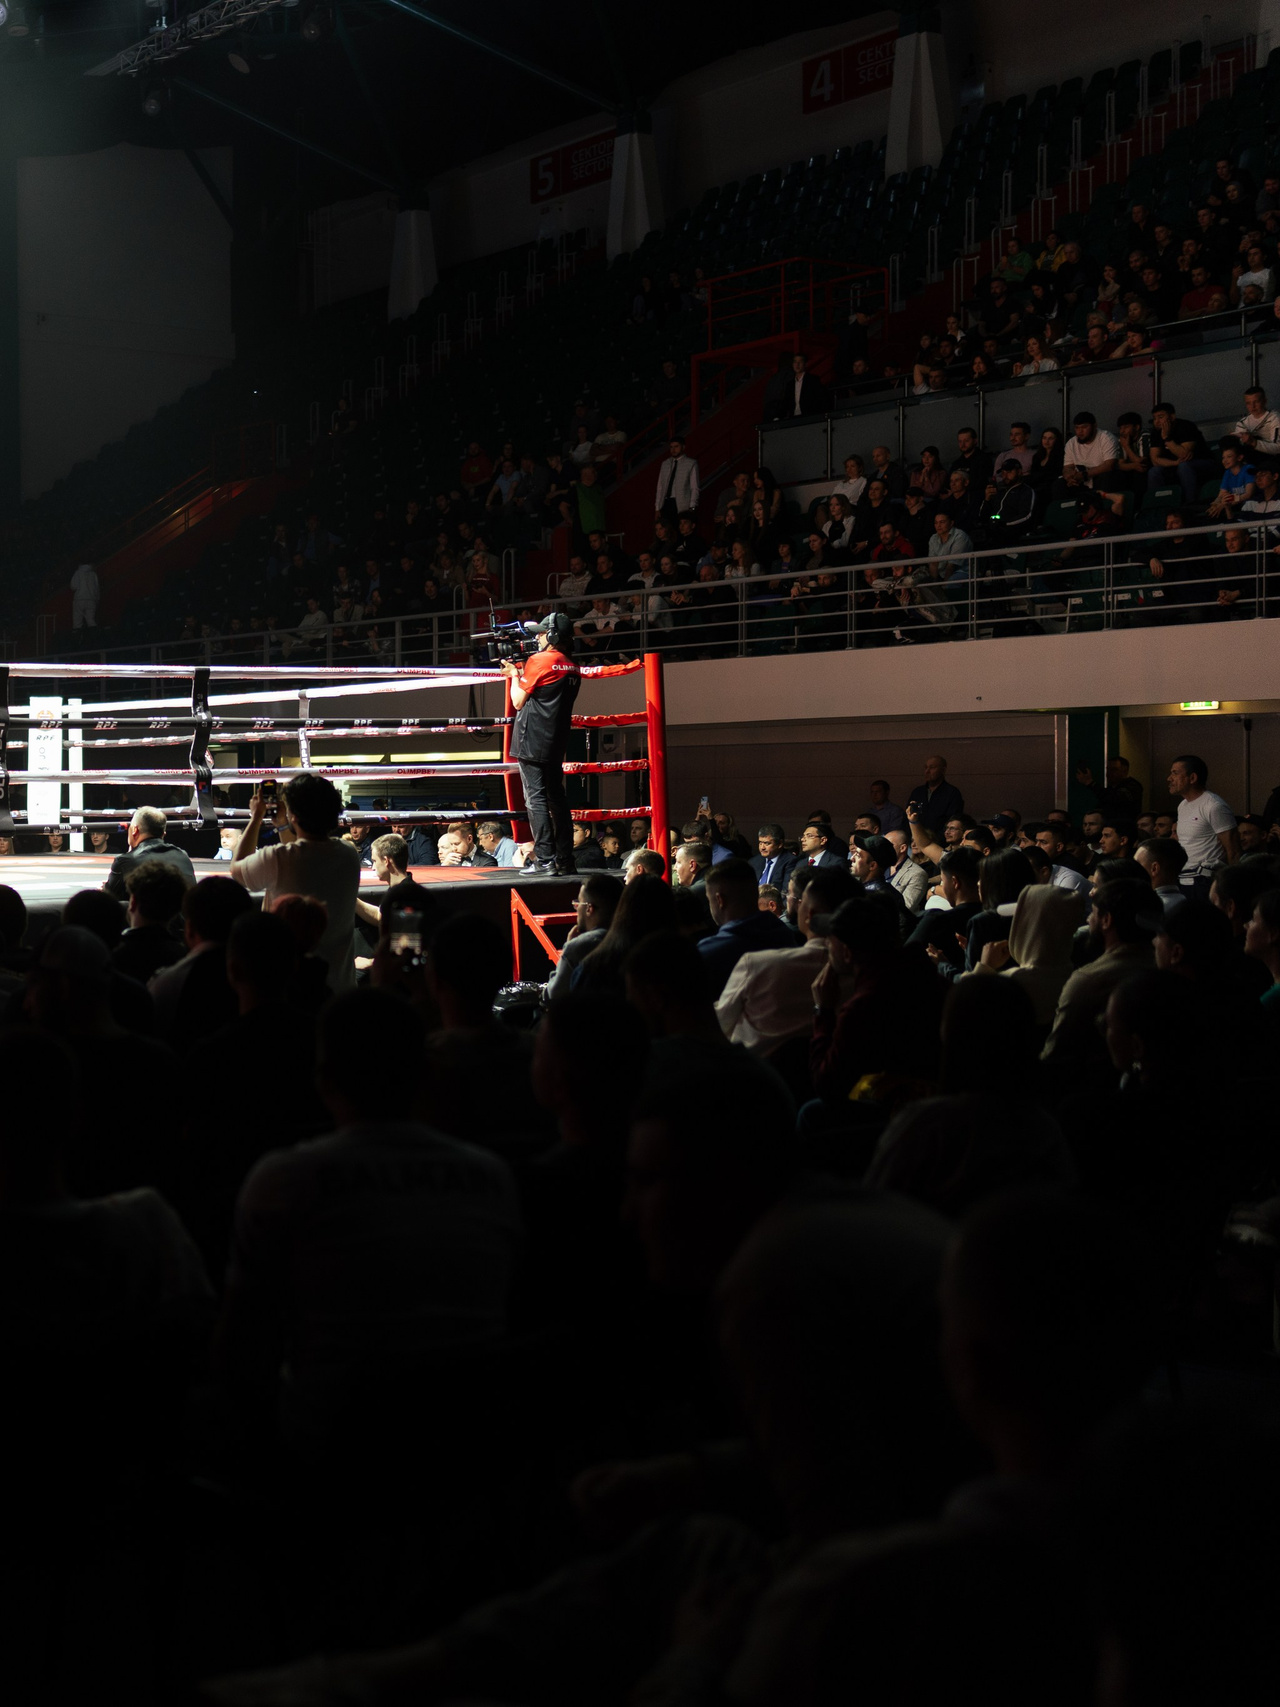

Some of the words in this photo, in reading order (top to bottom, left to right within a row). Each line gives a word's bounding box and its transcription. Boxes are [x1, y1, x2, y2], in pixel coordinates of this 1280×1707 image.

[810, 59, 834, 102] 4
[858, 60, 894, 85] SECT
[537, 156, 555, 196] 5
[580, 666, 603, 674] IGHT
[603, 760, 633, 770] RATEL
[609, 808, 641, 817] RATEL
